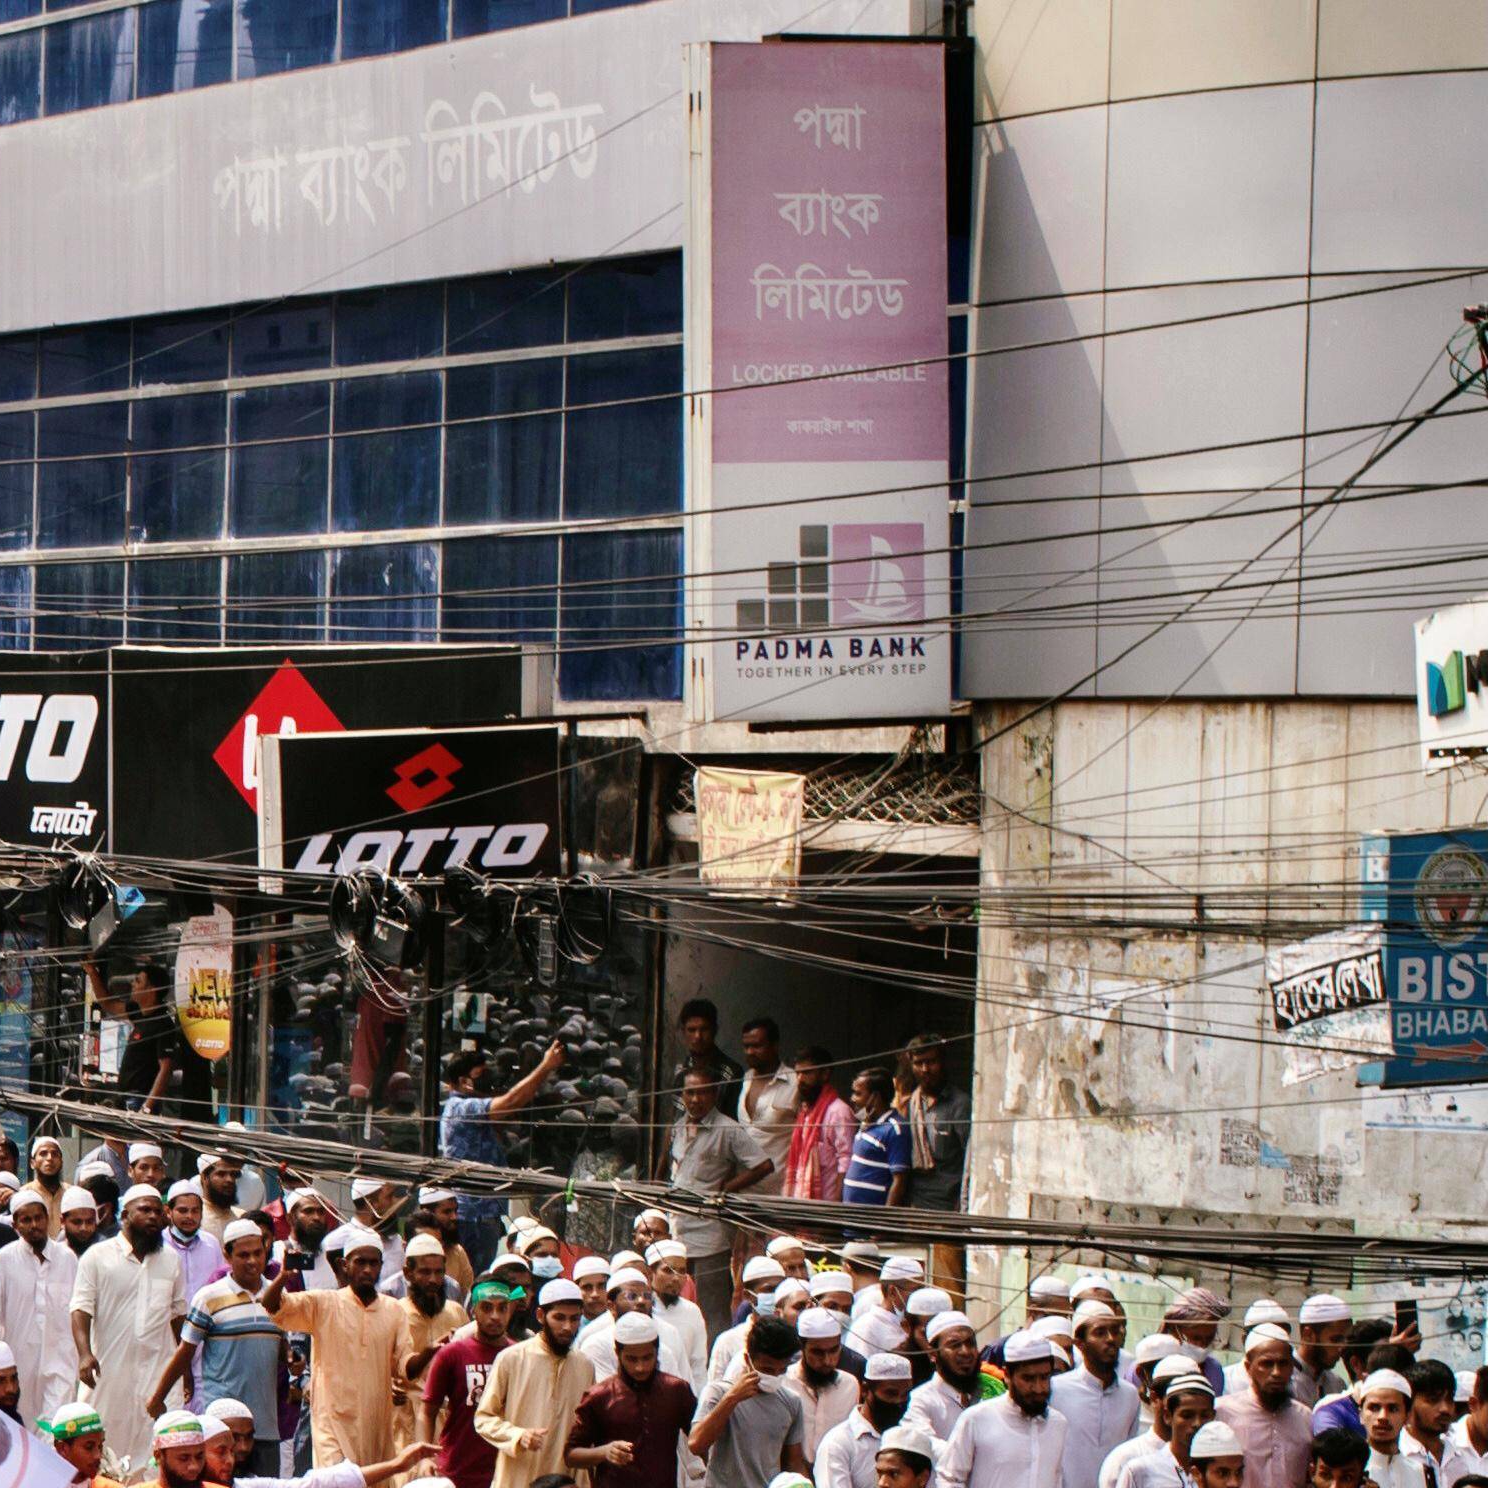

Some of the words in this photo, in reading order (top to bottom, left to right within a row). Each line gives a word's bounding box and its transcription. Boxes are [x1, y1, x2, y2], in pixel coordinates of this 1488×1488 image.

[794, 102, 867, 150] পদ্মা
[214, 147, 286, 238] পদ্মা
[297, 134, 411, 227] ব্যাংক
[420, 82, 605, 206] লিমিটেড
[773, 188, 884, 239] ব্যাংক
[749, 263, 910, 321] লিমিটেড
[732, 364, 813, 385] LOCKER
[818, 362, 927, 383] AVAILABLE
[736, 639, 834, 660] PADMA
[850, 636, 925, 658] BANK
[737, 666, 813, 679] TOGETHER
[819, 664, 833, 676] IN
[840, 663, 885, 676] EVERY
[892, 663, 926, 675] STEP
[294, 823, 549, 877] LOTTO
